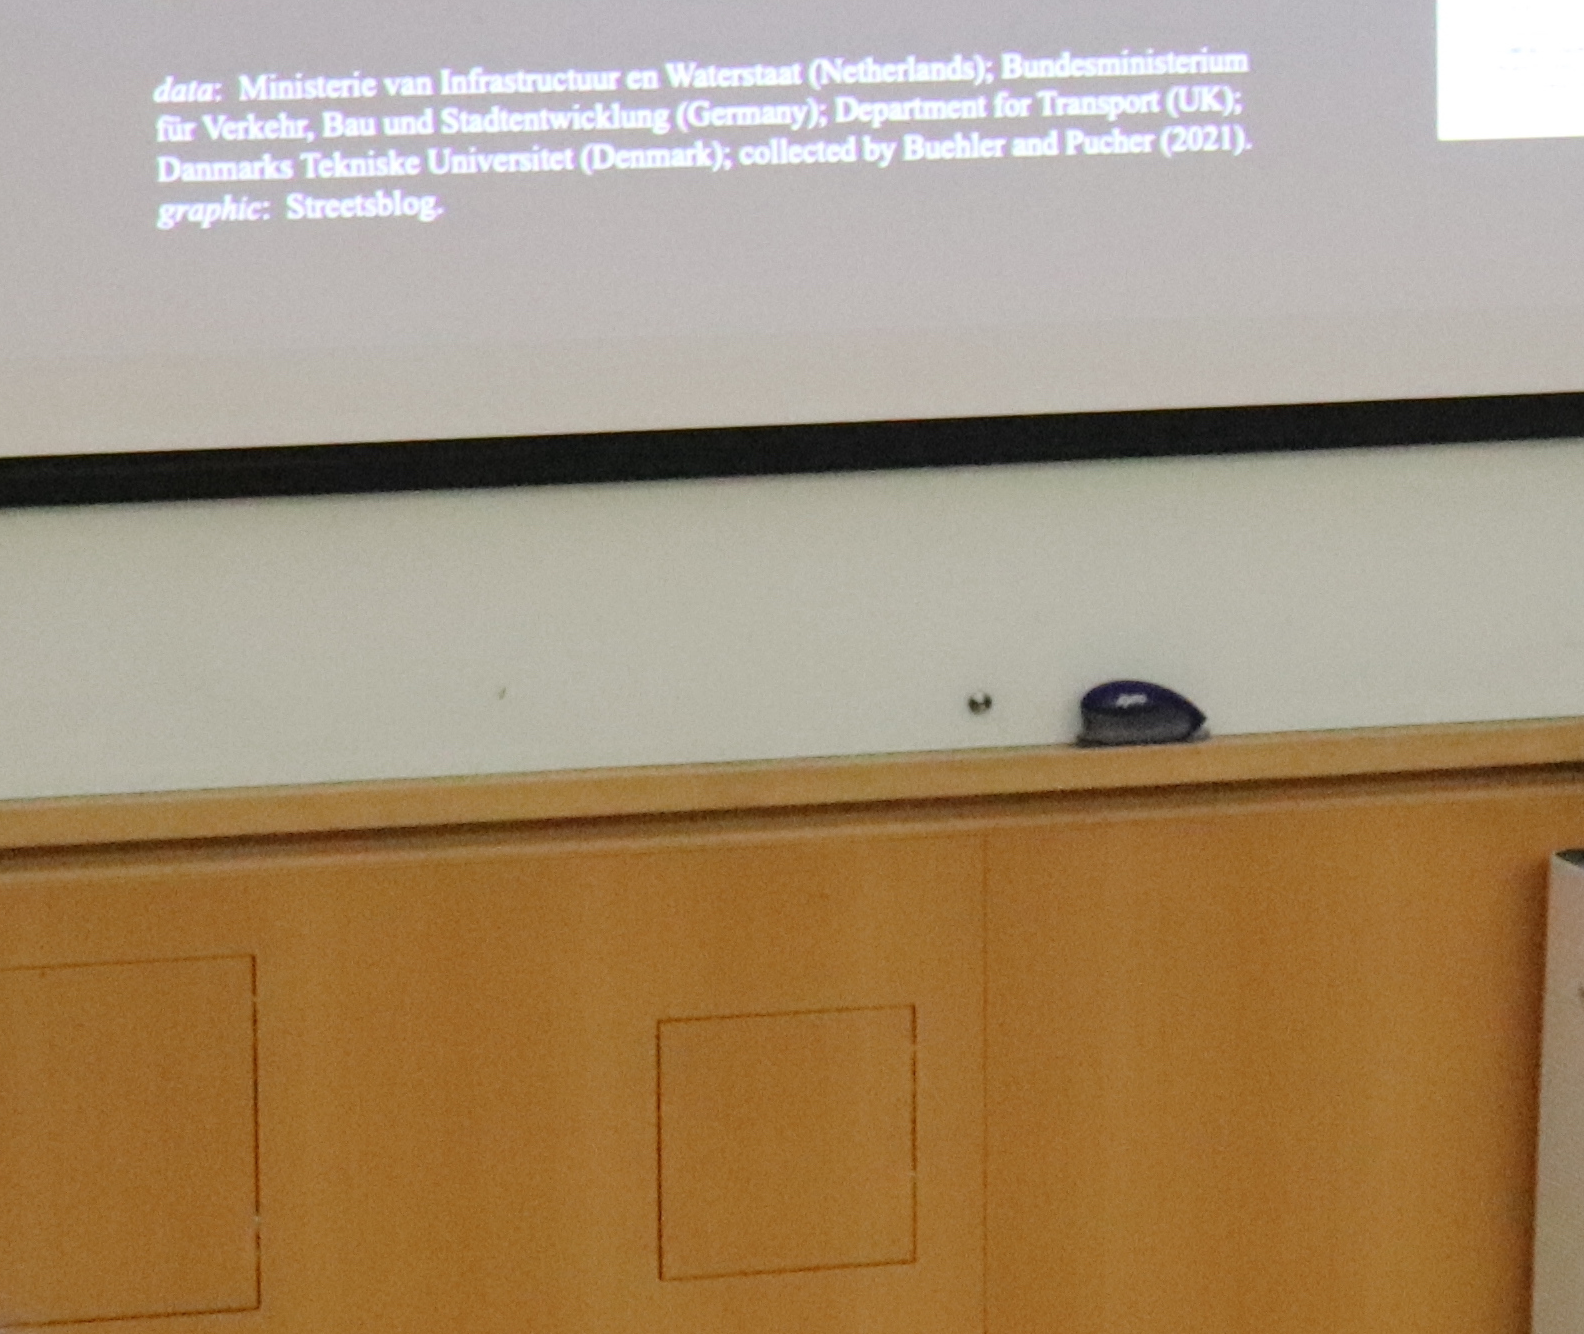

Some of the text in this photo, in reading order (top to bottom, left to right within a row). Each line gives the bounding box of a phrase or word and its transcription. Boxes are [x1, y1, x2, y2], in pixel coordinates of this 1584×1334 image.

[153, 48, 1248, 104] data: Ministerie van Infrastructuur en Waterstaat (Netherlands); Bundesministerium
[202, 112, 314, 143] Verkehr,
[322, 111, 376, 137] Bau
[383, 108, 433, 134] und
[441, 104, 669, 139] Stadtentwicklung
[676, 98, 827, 131] (Germany);
[835, 92, 986, 126] Department
[993, 92, 1031, 118] for
[1038, 88, 1159, 120] Transport
[1166, 86, 1243, 118] (UK);
[156, 123, 1252, 183] Danmarks Tekniske Universitet (Denmark); collected by Buehler and Pucher (2021).
[157, 191, 444, 229] graphic: Streetsblog.
